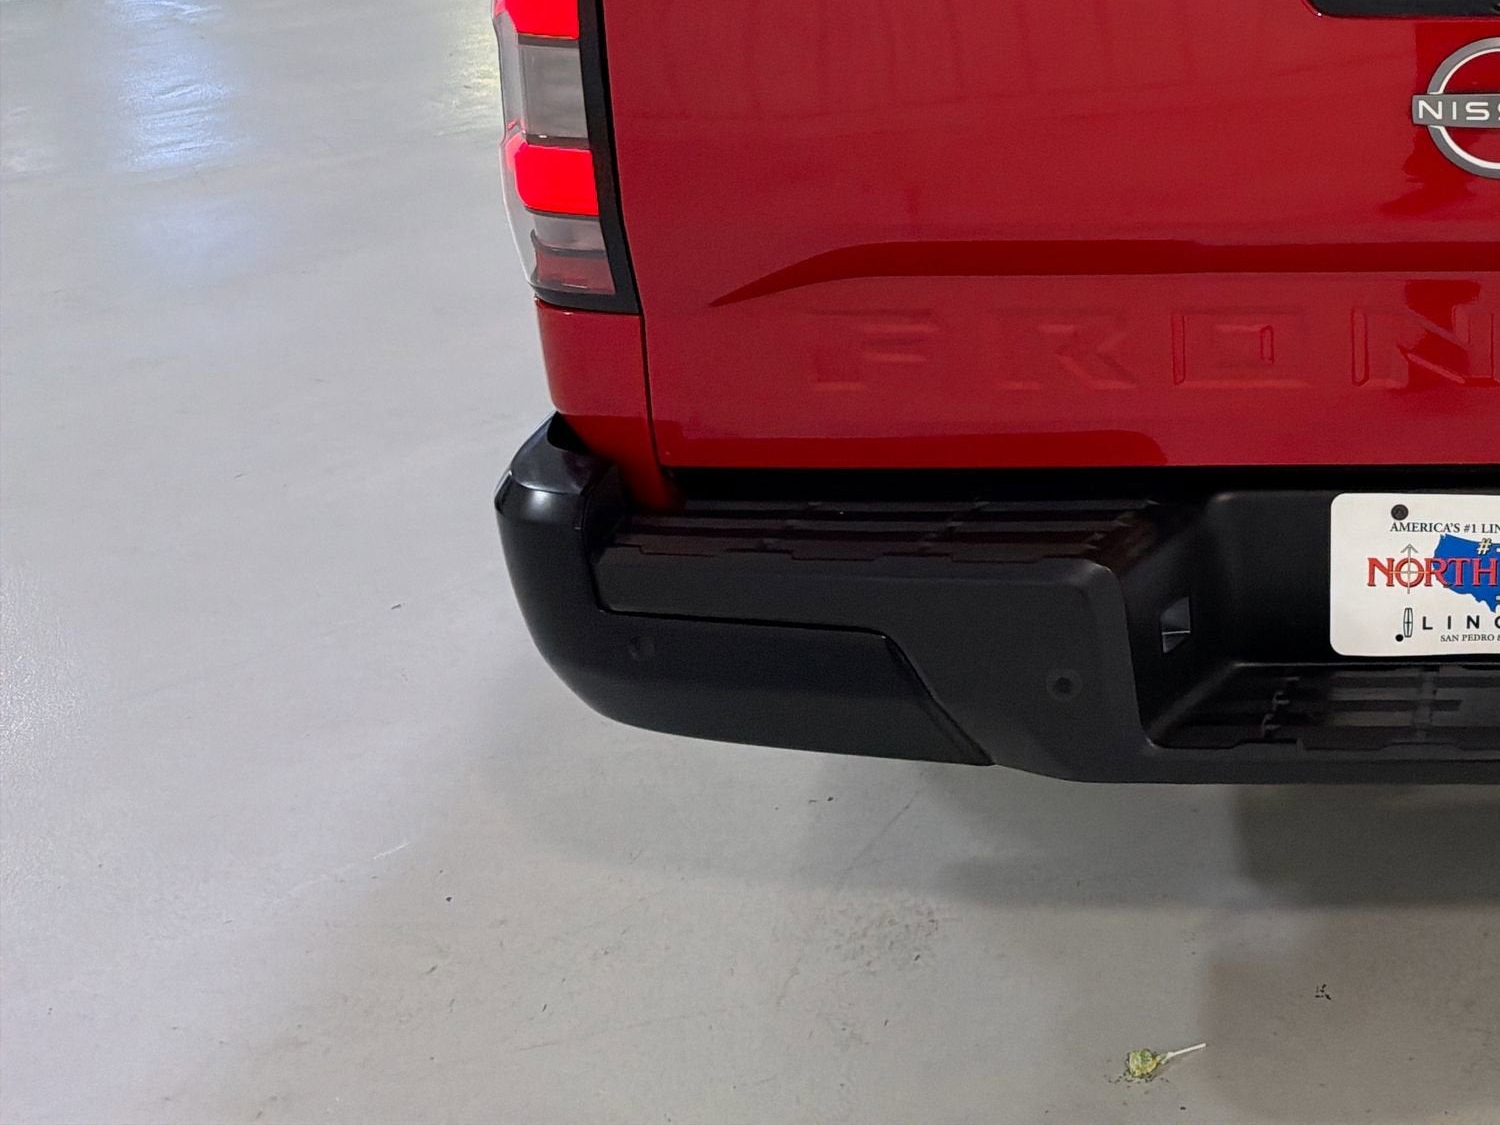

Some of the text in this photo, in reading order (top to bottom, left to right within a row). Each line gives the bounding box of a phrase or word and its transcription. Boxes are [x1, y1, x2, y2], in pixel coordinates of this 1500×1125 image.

[1389, 522, 1461, 533] AMERICA'S
[1463, 523, 1477, 533] #1
[1367, 557, 1498, 589] NORTH
[1440, 634, 1460, 643] SAN
[1462, 634, 1495, 642] PEDRO
